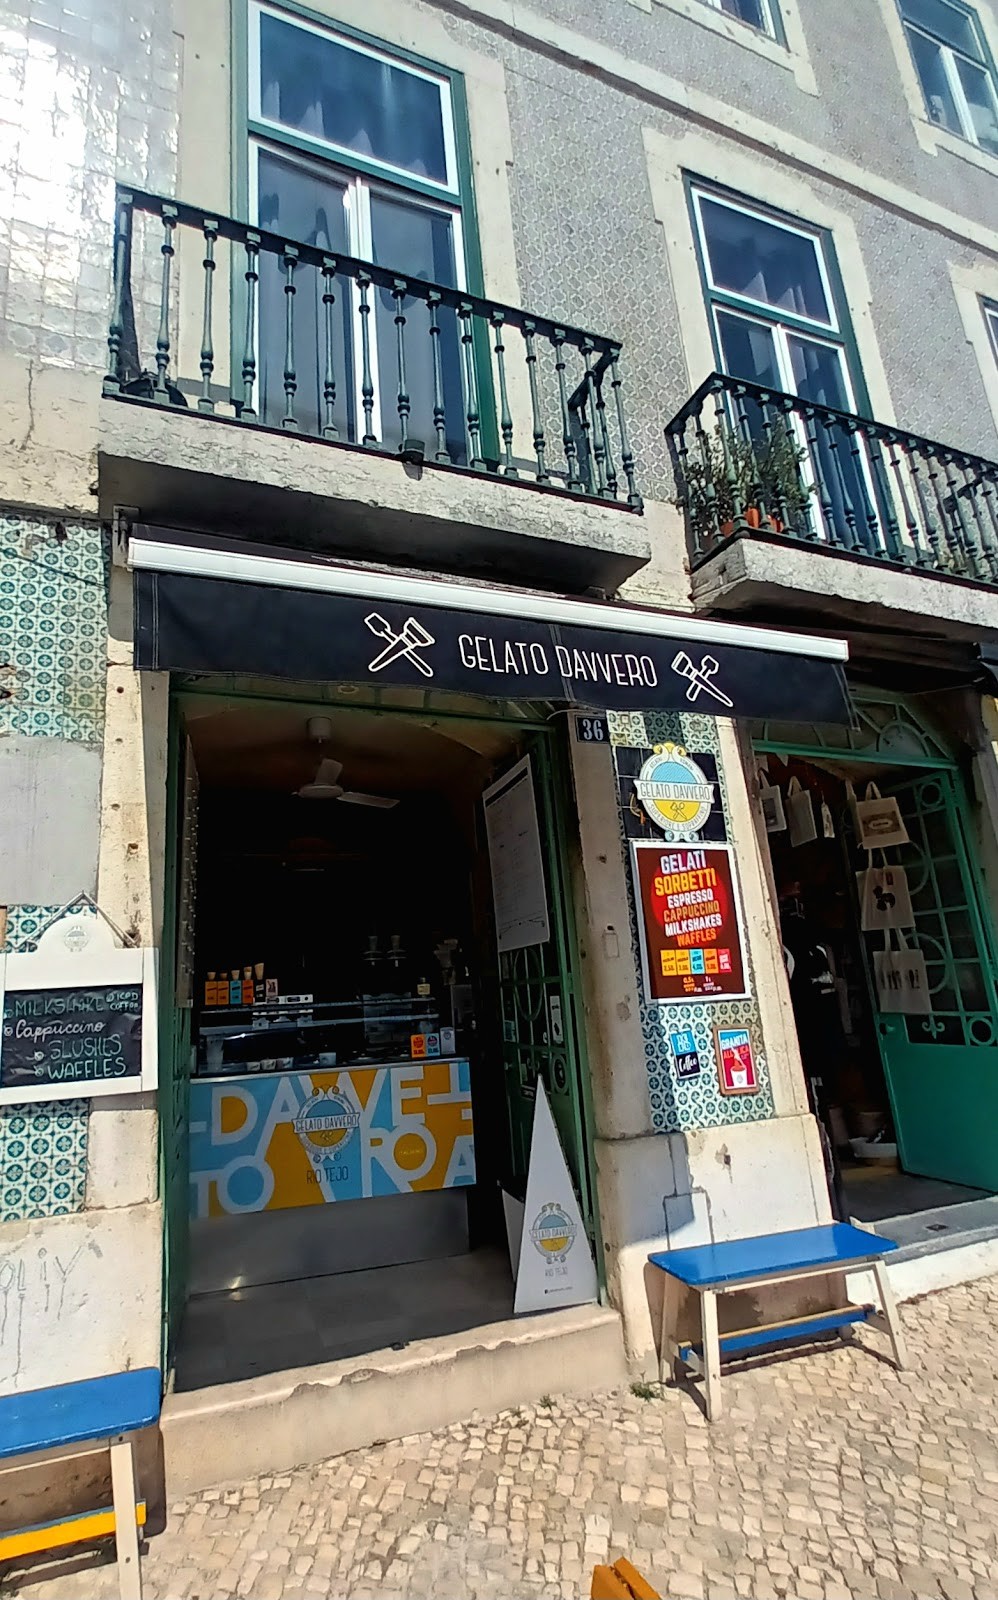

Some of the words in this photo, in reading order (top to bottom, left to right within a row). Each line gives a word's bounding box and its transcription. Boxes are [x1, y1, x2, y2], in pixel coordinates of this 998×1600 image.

[458, 634, 549, 675] GELATO
[555, 645, 658, 688] DAVVERO
[582, 718, 604, 741] 36
[640, 782, 671, 798] GELATO
[673, 784, 711, 801] DAVVERO
[660, 850, 707, 875] GELATI
[654, 868, 717, 896] SORBETTI
[667, 888, 714, 909] ESPRESSO
[663, 900, 720, 922] CAPPUCCINO
[665, 913, 722, 937] MILKSHAKES
[677, 928, 717, 947] WAFFLES
[15, 996, 104, 1017] MILKSHAKE
[15, 1019, 106, 1043] Cappuccino
[47, 1057, 127, 1080] WAFFLES
[678, 1055, 697, 1072] Coffee
[295, 1118, 322, 1132] GELATO
[325, 1114, 357, 1129] DAVVERO
[306, 1169, 321, 1185] RIO
[324, 1166, 349, 1182] TEJO
